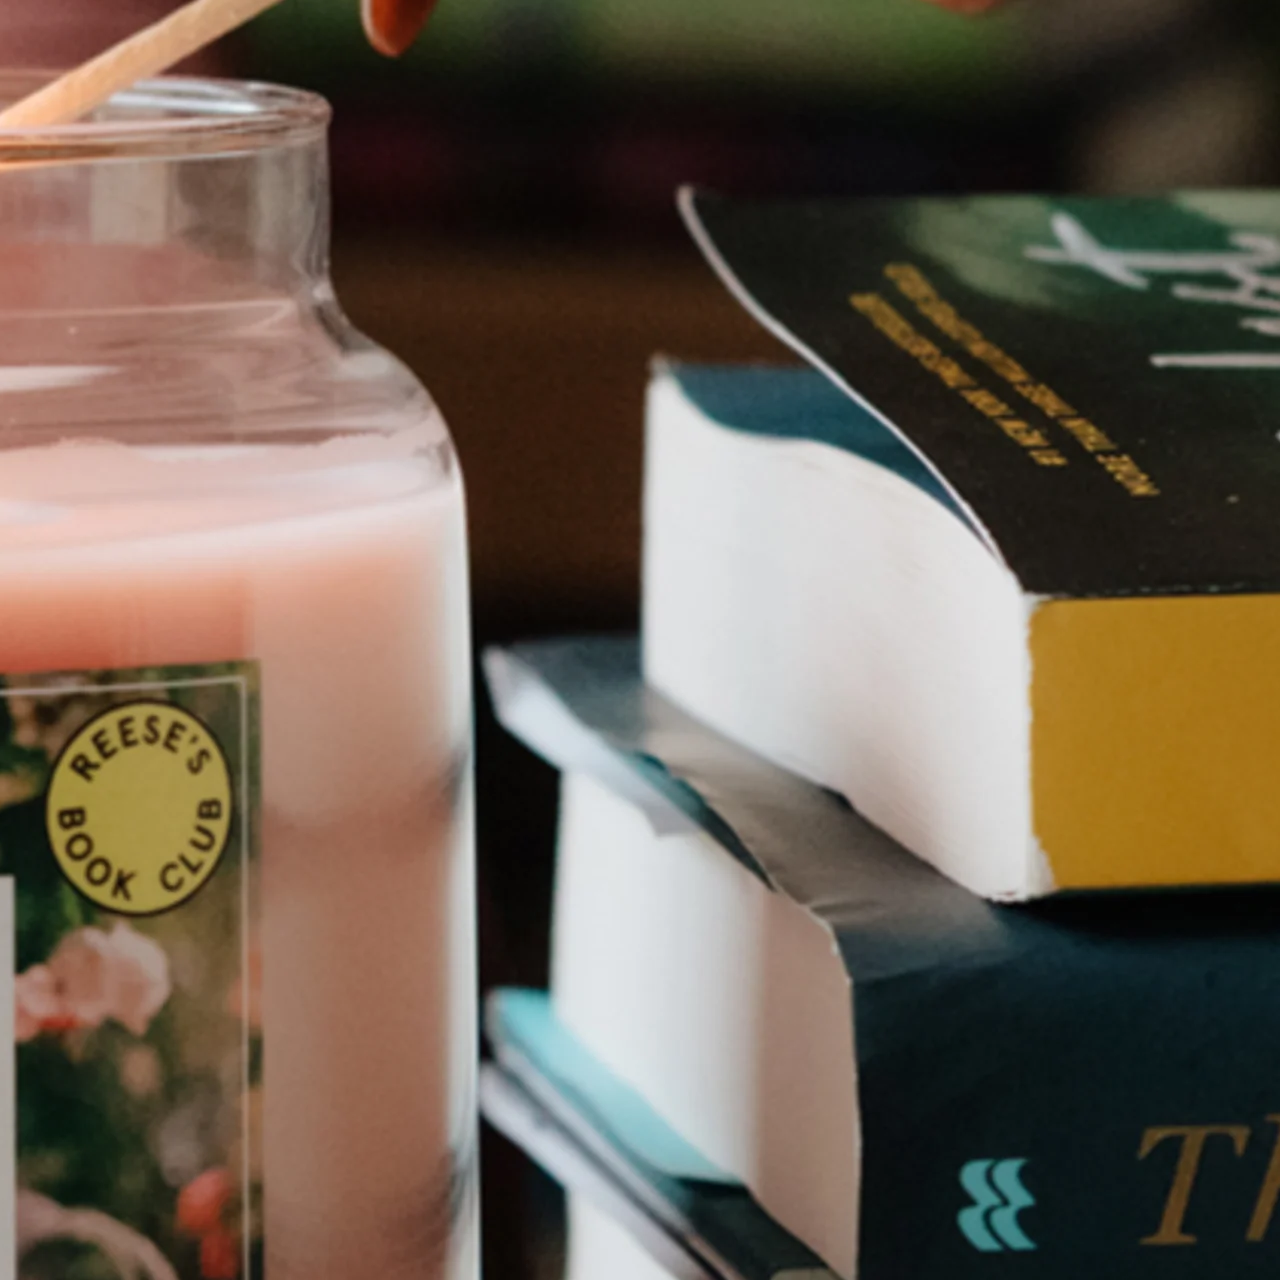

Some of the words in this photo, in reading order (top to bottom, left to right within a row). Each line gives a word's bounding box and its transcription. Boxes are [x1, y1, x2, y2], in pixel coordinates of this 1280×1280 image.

[69, 714, 213, 784] REESE'S
[56, 806, 138, 902] BOOK
[158, 797, 223, 894] CLUB
